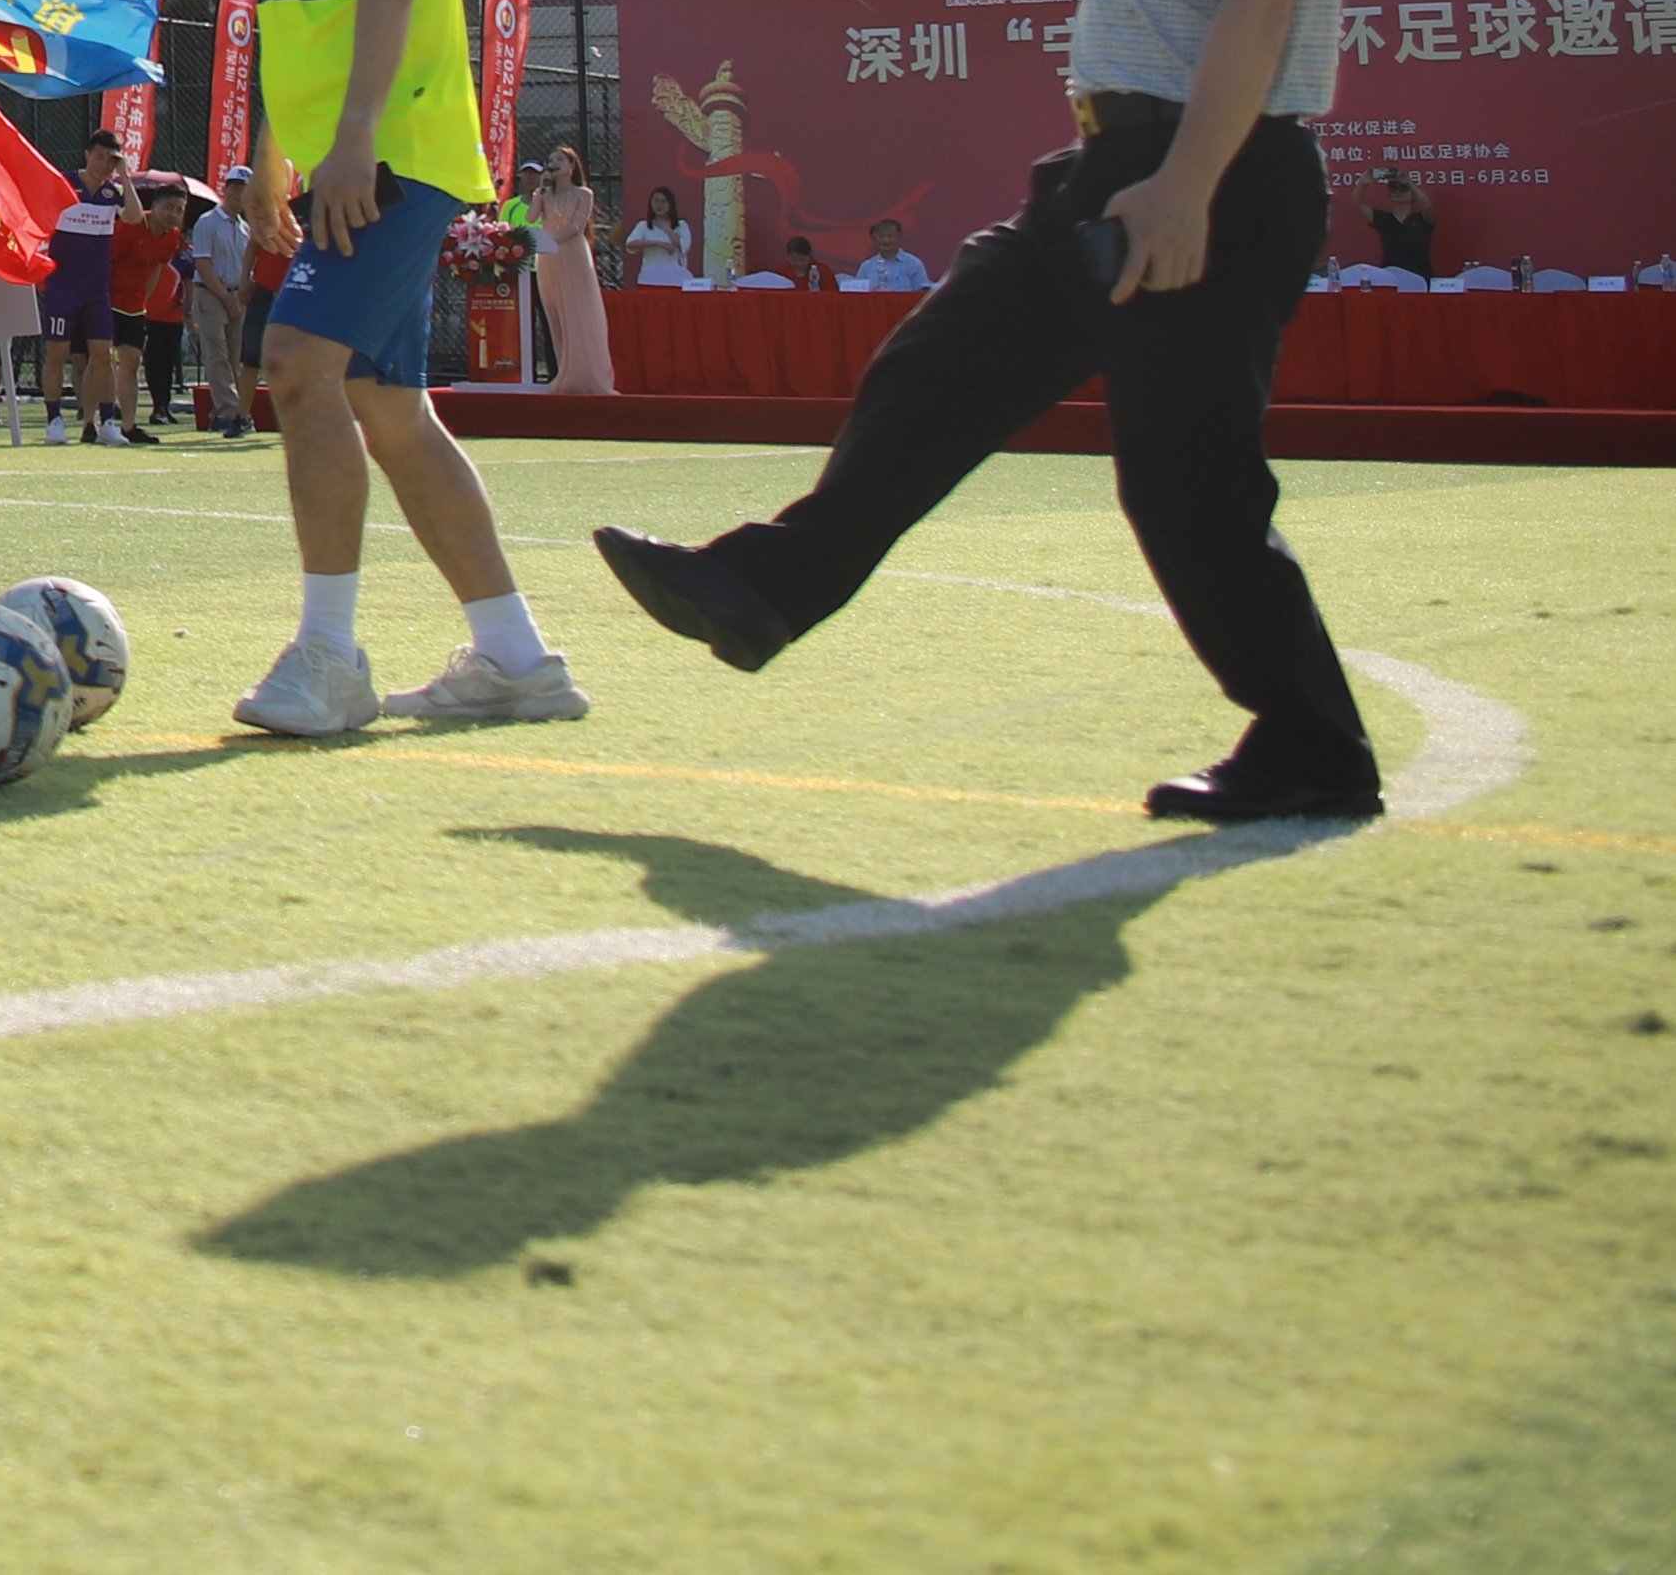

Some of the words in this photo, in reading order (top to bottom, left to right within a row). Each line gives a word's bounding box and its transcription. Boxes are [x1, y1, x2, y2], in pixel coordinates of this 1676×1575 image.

[1307, 119, 1417, 137] 江文化促进会
[49, 316, 66, 336] 10
